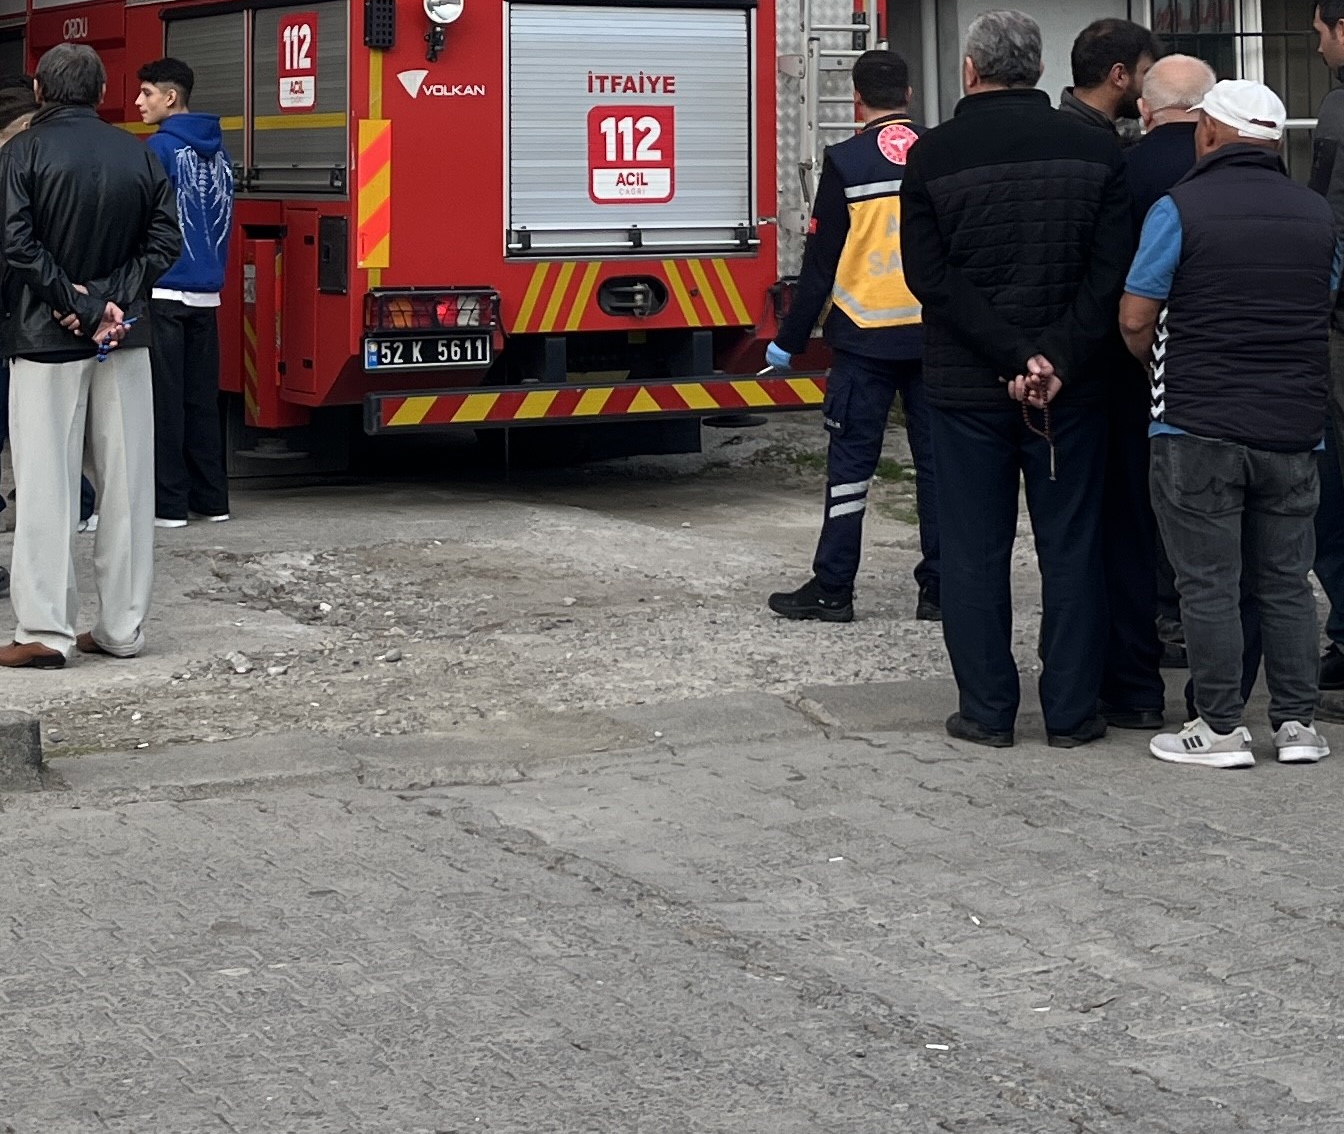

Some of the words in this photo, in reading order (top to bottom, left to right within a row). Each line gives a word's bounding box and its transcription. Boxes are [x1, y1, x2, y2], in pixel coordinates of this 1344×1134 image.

[63, 17, 88, 39] ORDU
[283, 24, 311, 69] 112
[422, 85, 485, 96] VOLKAN
[587, 70, 676, 94] İTFAİYE
[600, 116, 662, 161] 112
[381, 341, 404, 364] 52
[412, 341, 423, 363] K
[437, 338, 483, 362] 5611
